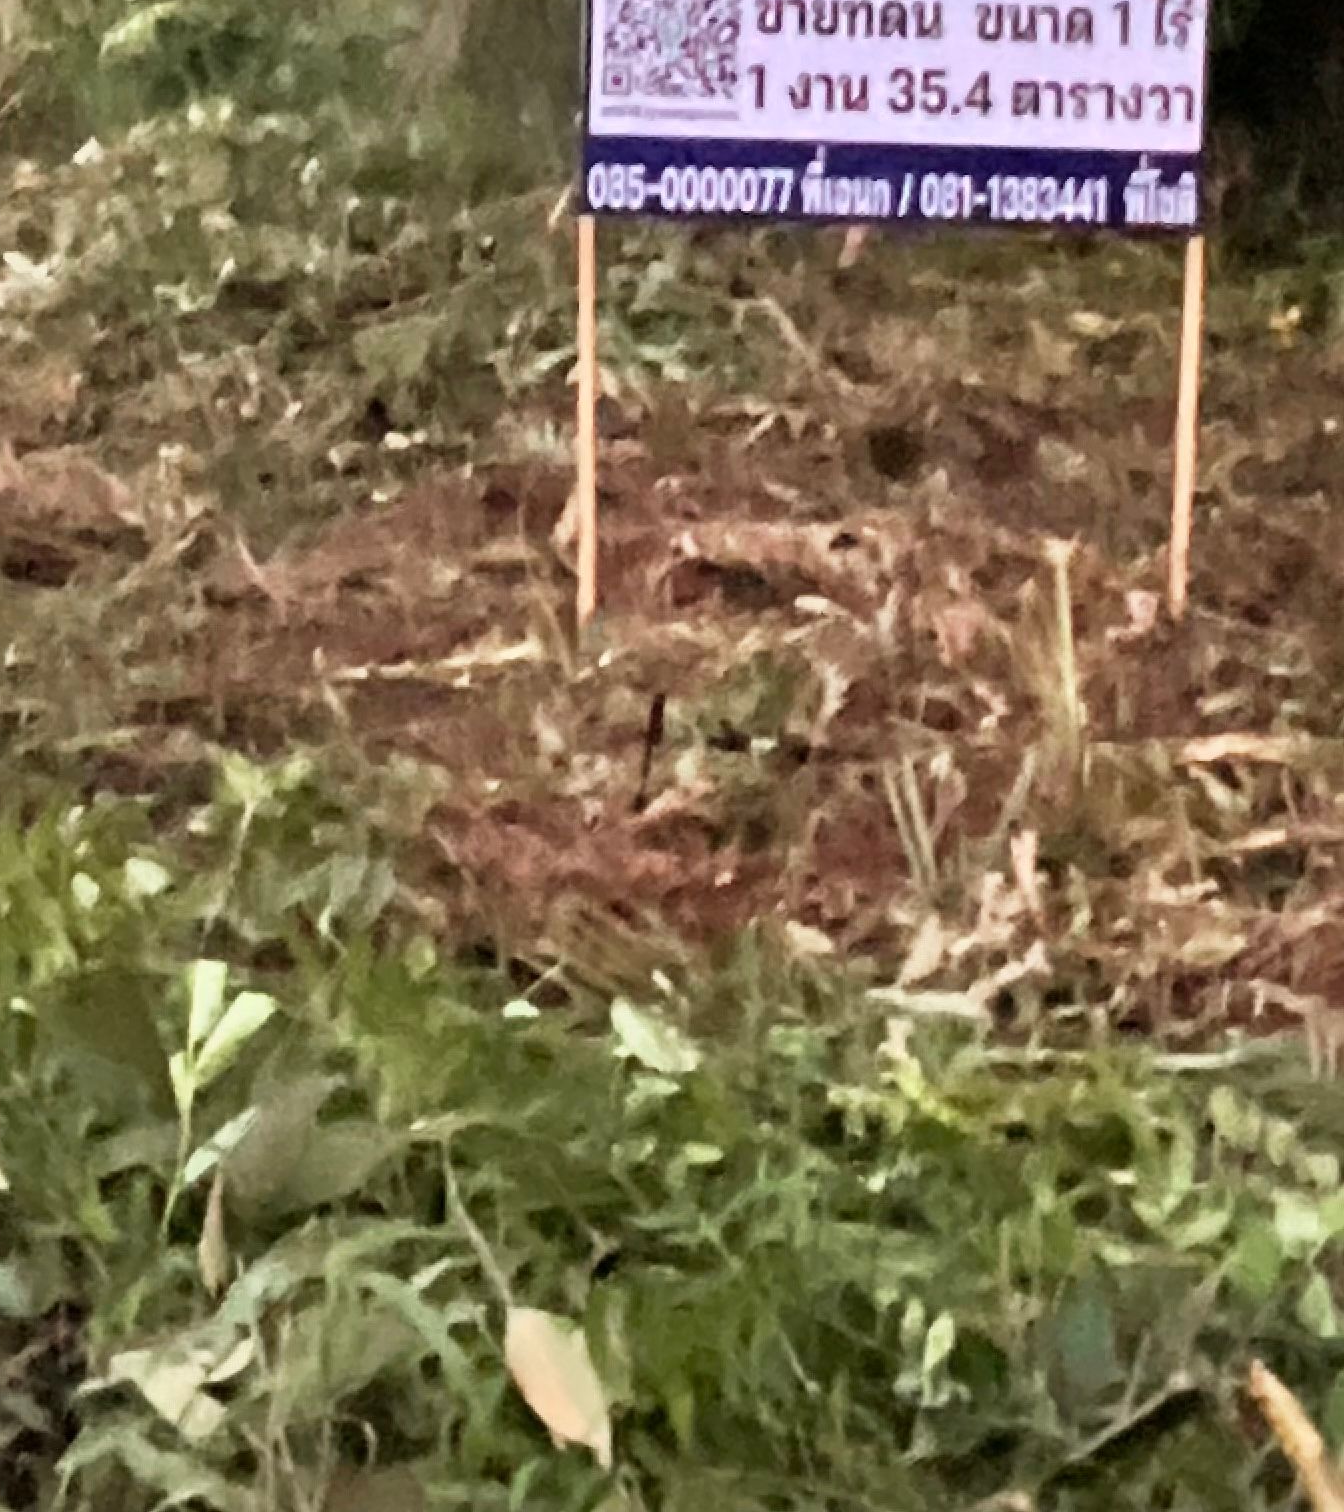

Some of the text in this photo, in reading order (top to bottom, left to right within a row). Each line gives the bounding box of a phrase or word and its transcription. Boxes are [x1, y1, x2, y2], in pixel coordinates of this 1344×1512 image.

[976, 3, 1093, 44] ขนาด
[1113, 0, 1130, 46] 1
[748, 65, 1194, 121] 1 งาน 35.4 ตารางวา
[588, 162, 794, 212] 085-0000077
